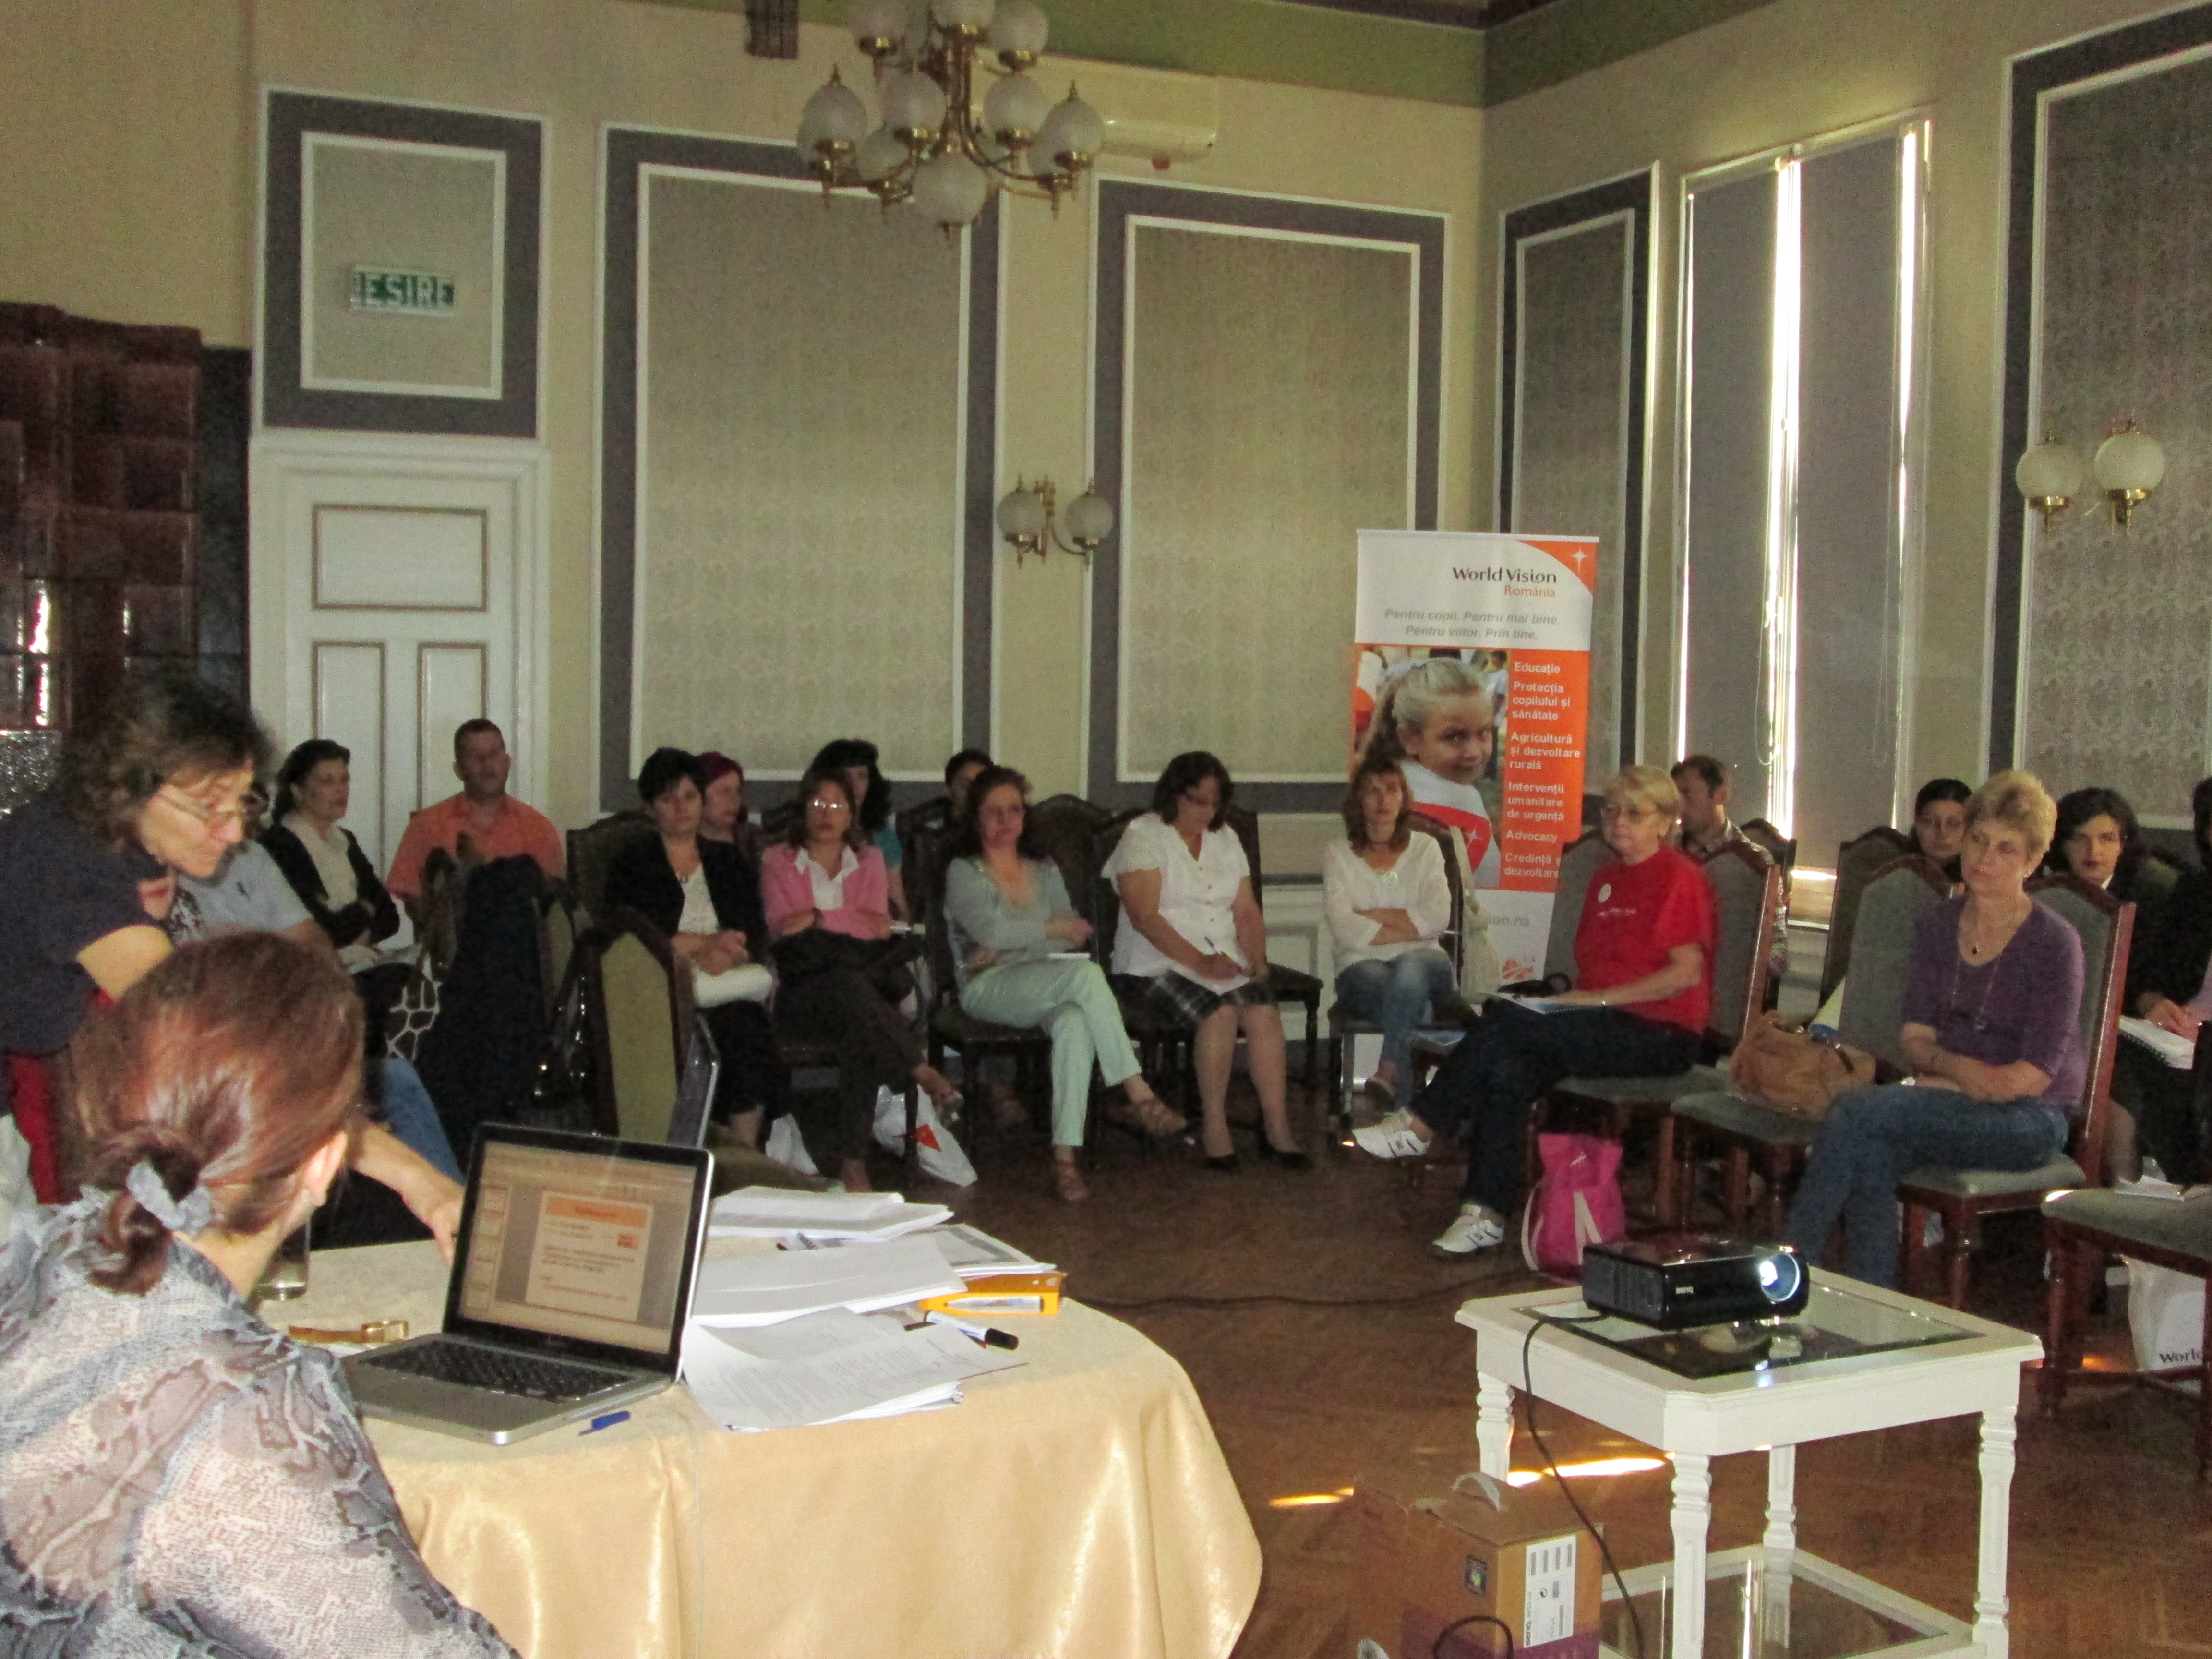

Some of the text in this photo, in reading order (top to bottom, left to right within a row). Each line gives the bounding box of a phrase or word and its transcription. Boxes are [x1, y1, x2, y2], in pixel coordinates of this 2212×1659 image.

[1453, 567, 1556, 584] World Vision
[1504, 584, 1556, 598] România
[1385, 609, 1424, 619] Pentru
[1464, 612, 1503, 622] Pentru
[1506, 613, 1528, 623] mai
[1406, 625, 1445, 636] Pentru
[1486, 628, 1510, 638] Prin
[1513, 697, 1558, 707] copilului
[1510, 731, 1573, 745] Agricultură
[1524, 747, 1581, 757] dezvoltare
[1508, 797, 1563, 807] umanitare
[1507, 809, 1520, 818] de
[1506, 830, 1558, 844] Advocacy
